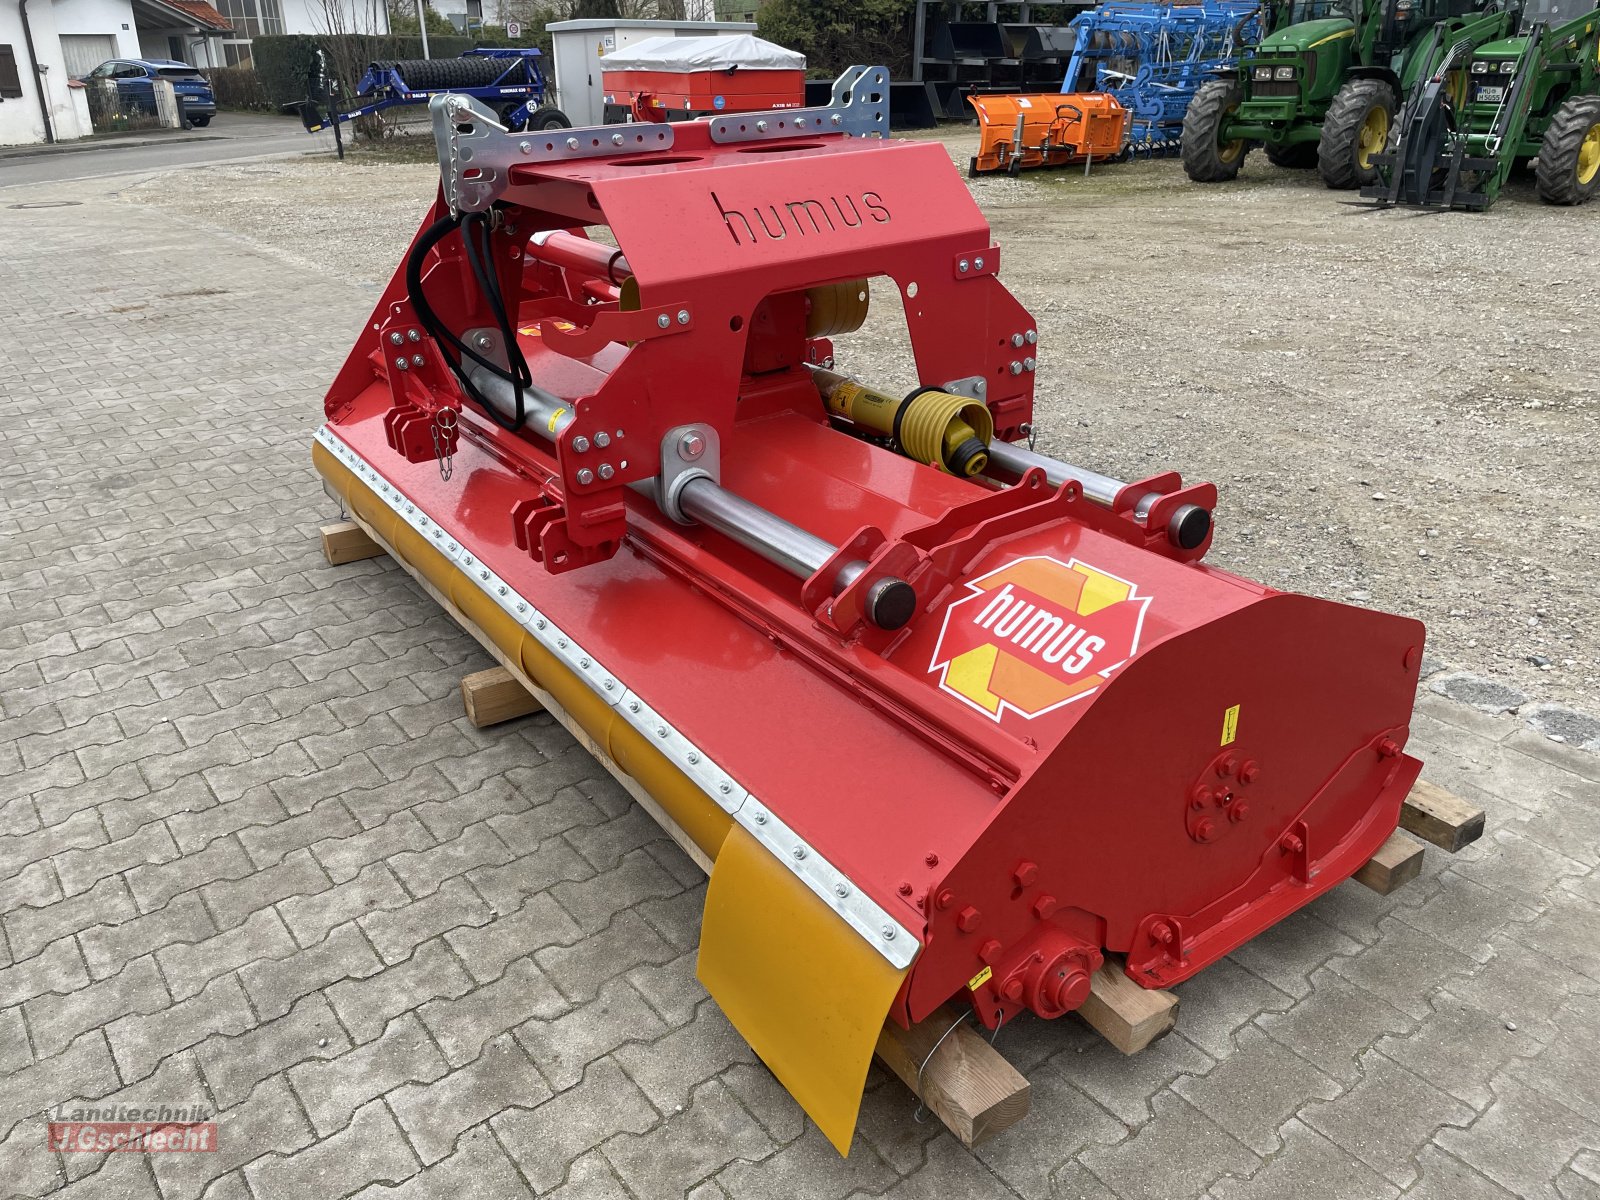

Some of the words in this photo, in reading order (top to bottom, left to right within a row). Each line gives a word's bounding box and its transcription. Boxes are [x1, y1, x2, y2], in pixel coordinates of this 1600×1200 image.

[528, 102, 536, 111] 25
[710, 191, 892, 246] humus
[972, 583, 1106, 675] humus
